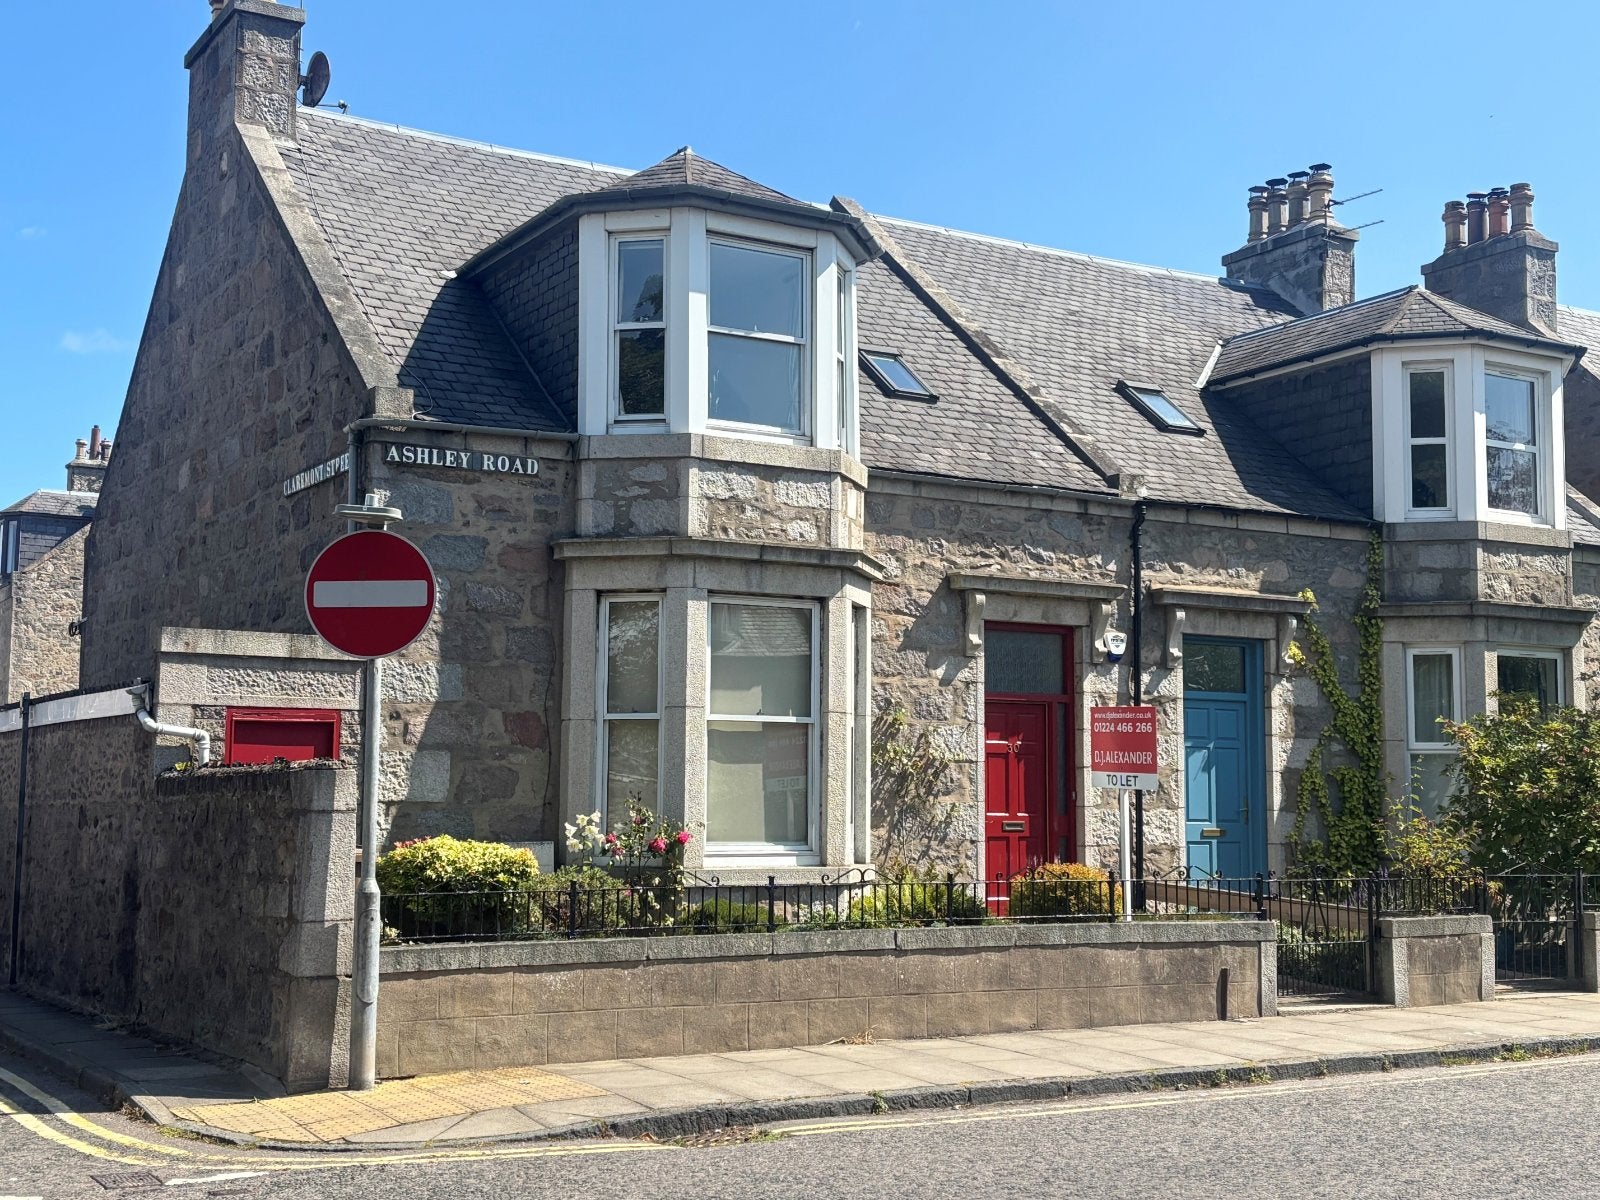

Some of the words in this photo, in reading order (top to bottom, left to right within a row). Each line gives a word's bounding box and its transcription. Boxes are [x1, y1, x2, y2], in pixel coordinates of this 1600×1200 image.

[386, 445, 472, 469] ASHLEY
[482, 454, 539, 475] ROAD
[283, 464, 324, 496] CLAREMONT
[326, 453, 350, 477] STREE
[1093, 722, 1115, 733] 01224
[1116, 722, 1134, 733] 466
[1135, 722, 1153, 733] 266
[1106, 774, 1118, 786] TO
[1120, 775, 1139, 787] LET
